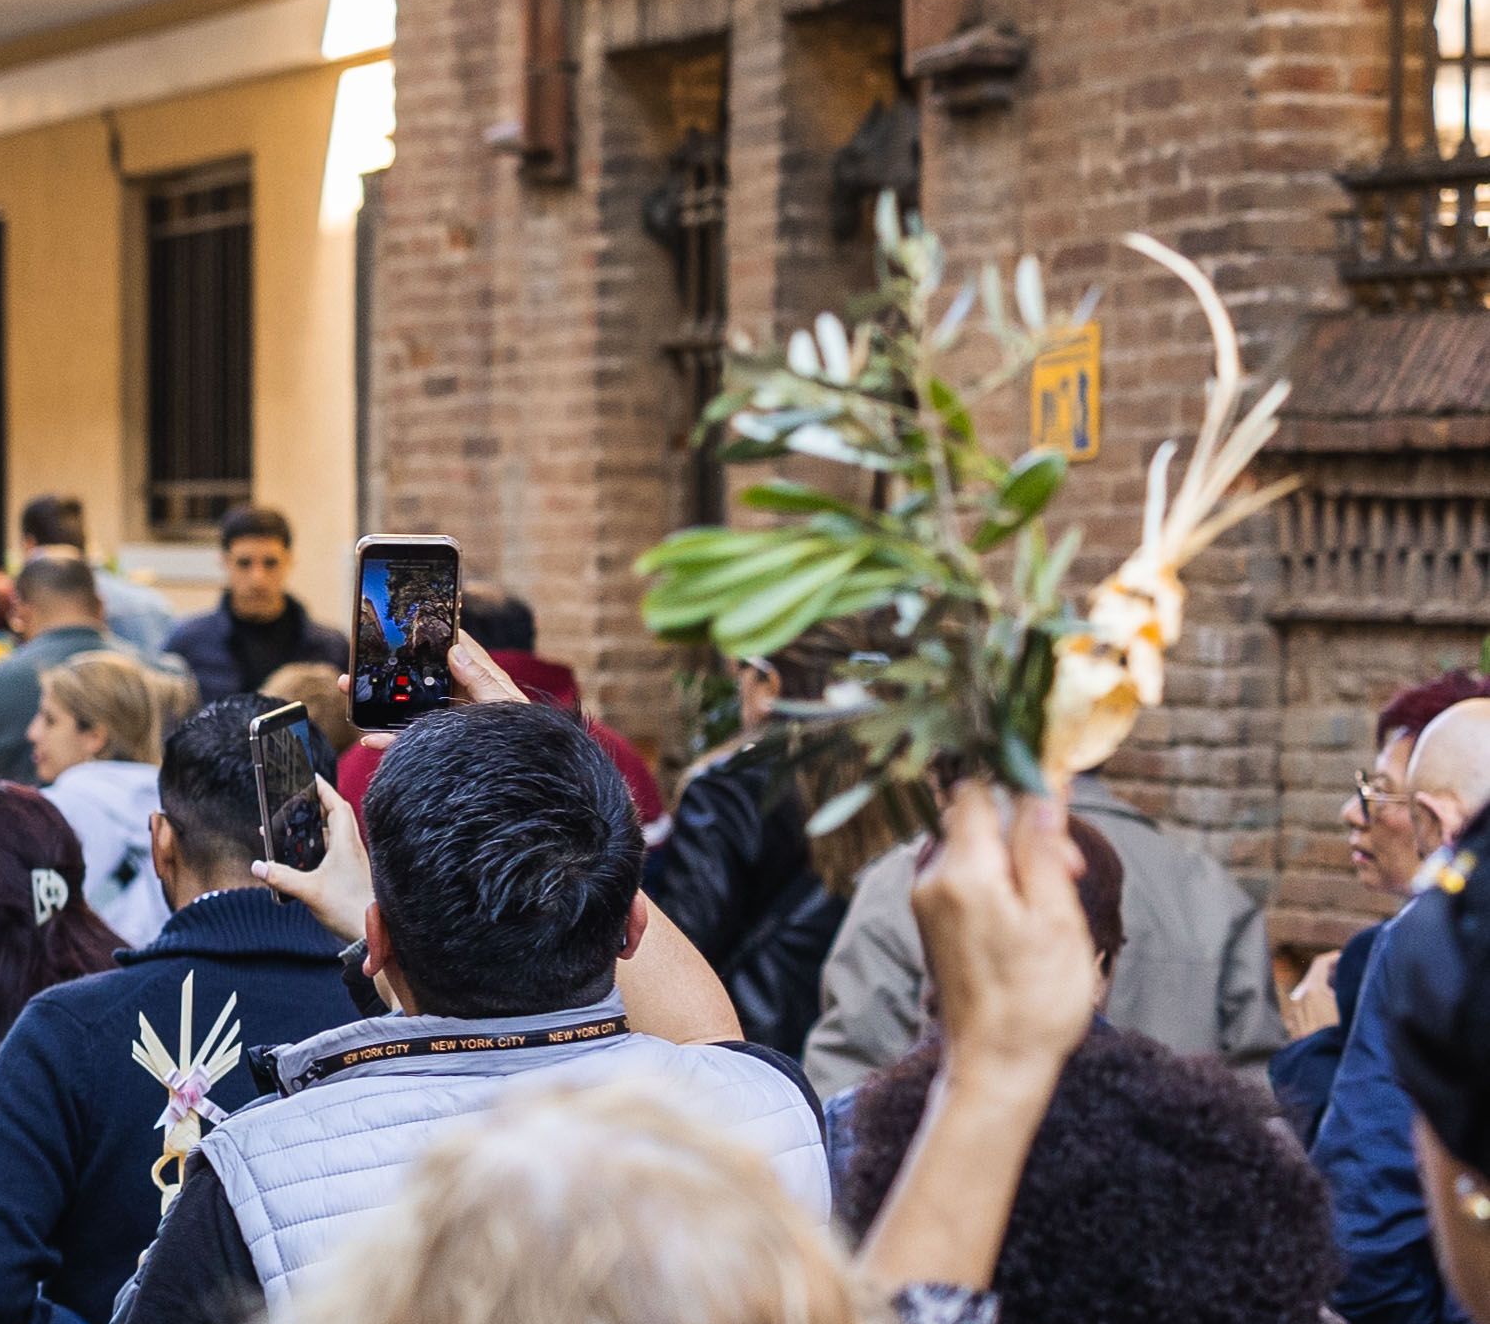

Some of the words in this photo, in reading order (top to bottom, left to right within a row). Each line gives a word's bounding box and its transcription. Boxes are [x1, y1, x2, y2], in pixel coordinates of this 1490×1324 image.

[548, 1030, 573, 1042] NEW
[575, 1025, 600, 1038] YORK
[431, 1040, 457, 1051] NEW
[459, 1038, 494, 1049] YORK
[497, 1036, 526, 1048] CITY
[360, 1047, 383, 1060] YORK
[386, 1044, 410, 1056] CITY
